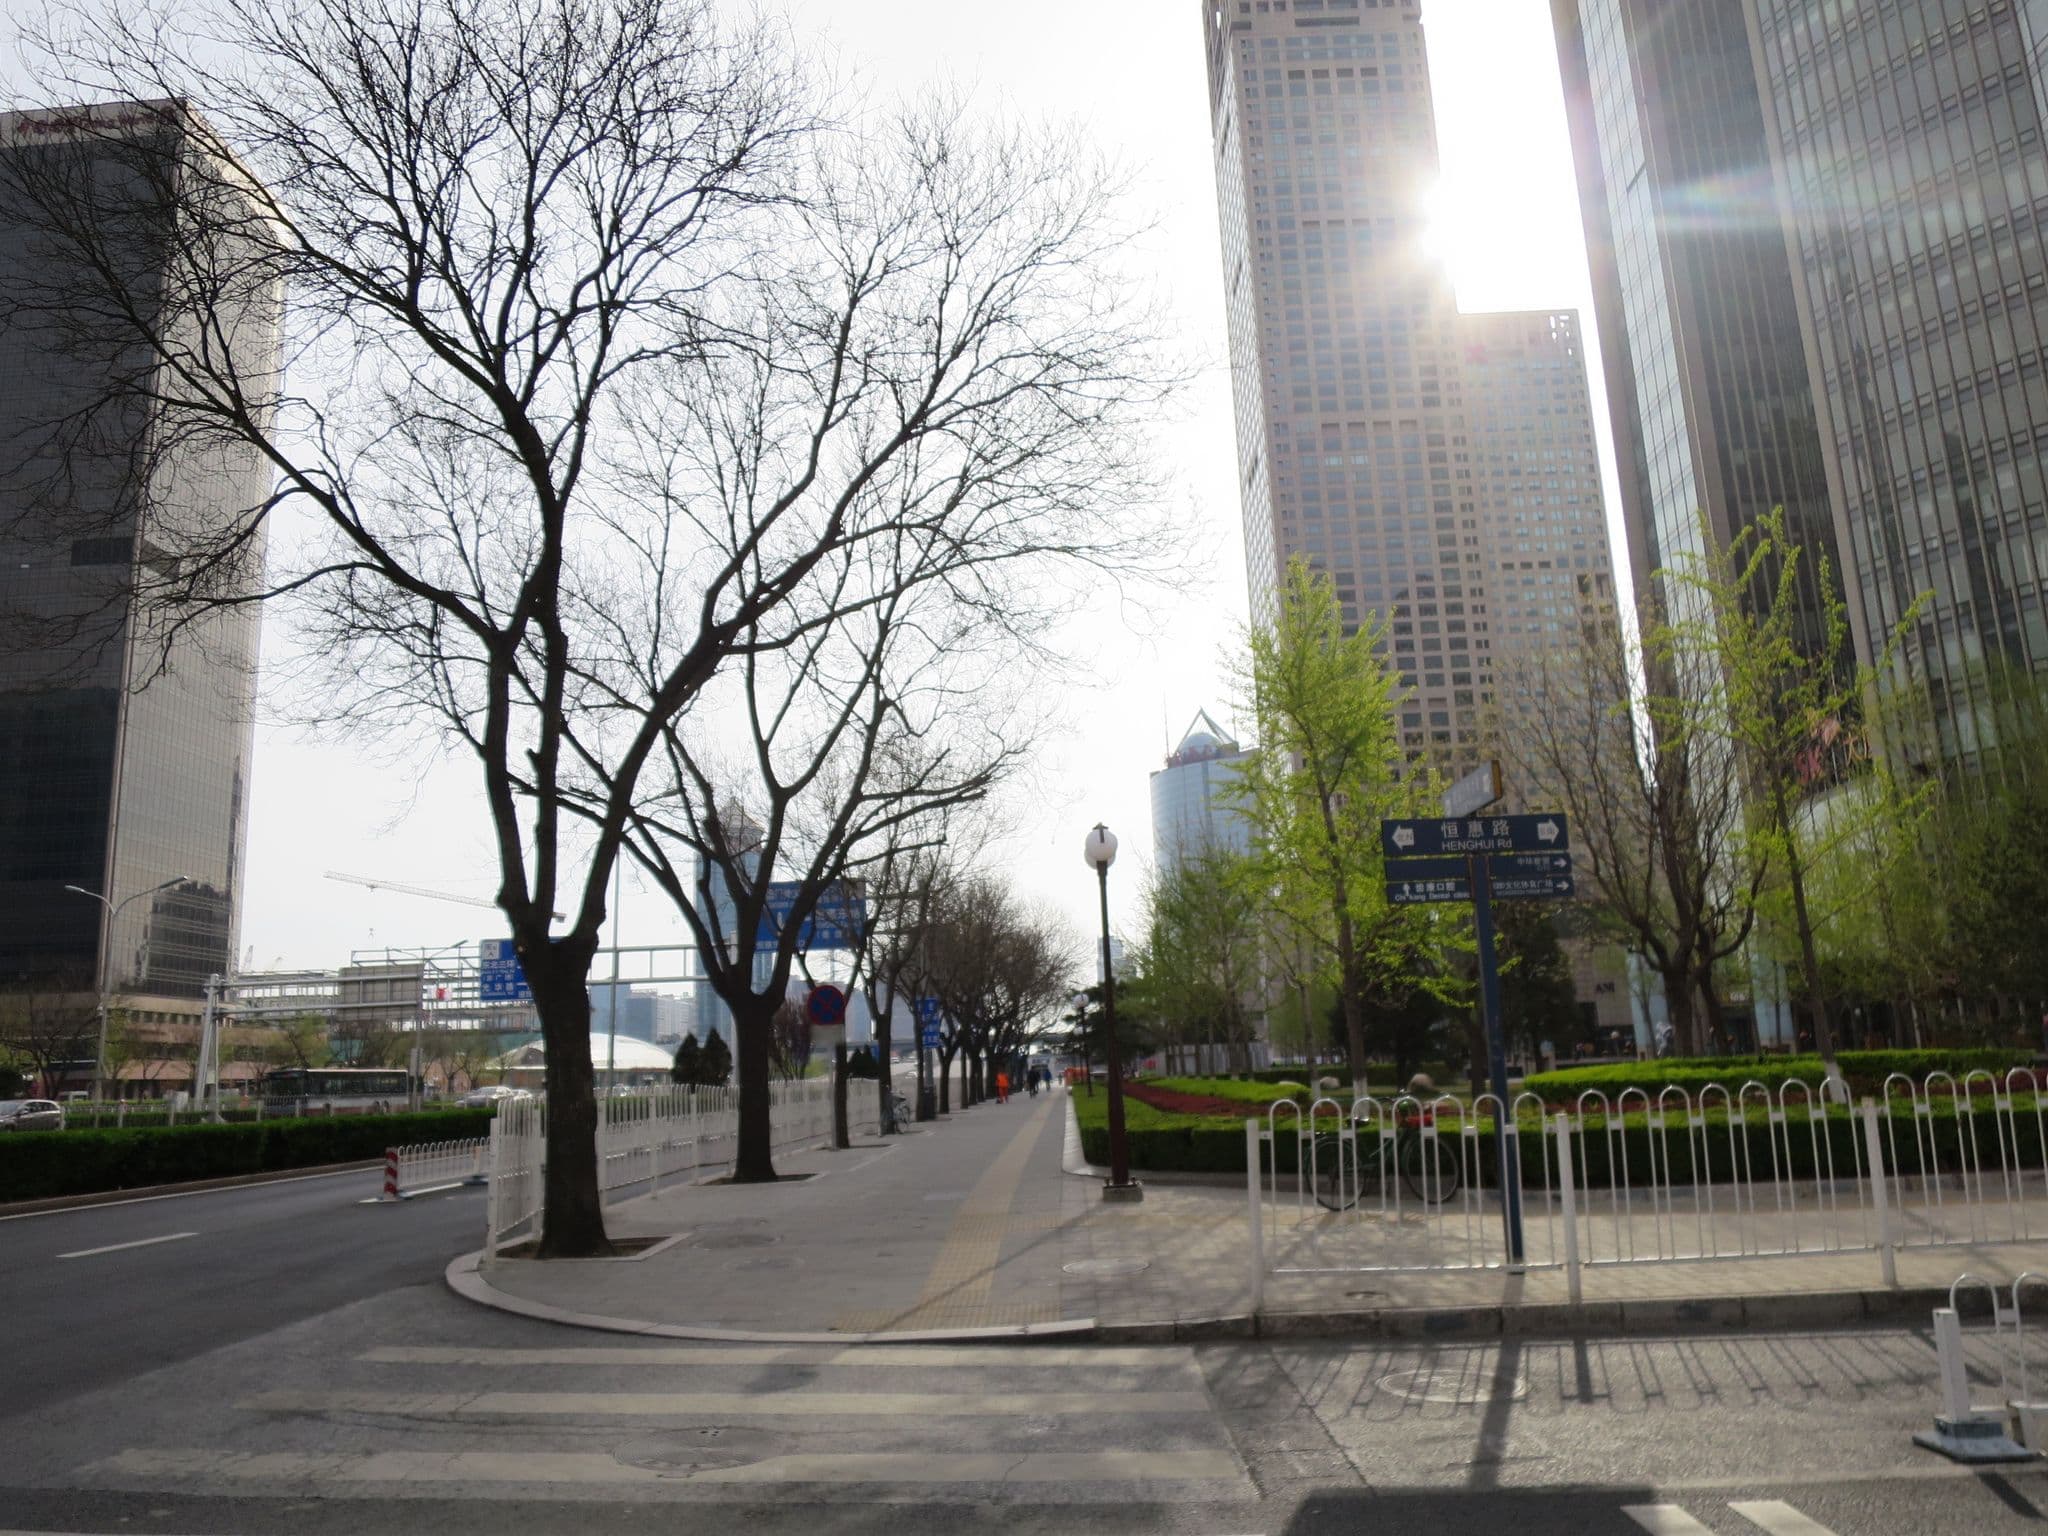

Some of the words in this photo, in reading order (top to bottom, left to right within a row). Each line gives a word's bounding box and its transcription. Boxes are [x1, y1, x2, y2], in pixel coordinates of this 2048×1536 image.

[1441, 819, 1510, 838] 恒惠路
[1441, 840, 1495, 851] HENGHUI
[1497, 838, 1513, 848] Rd
